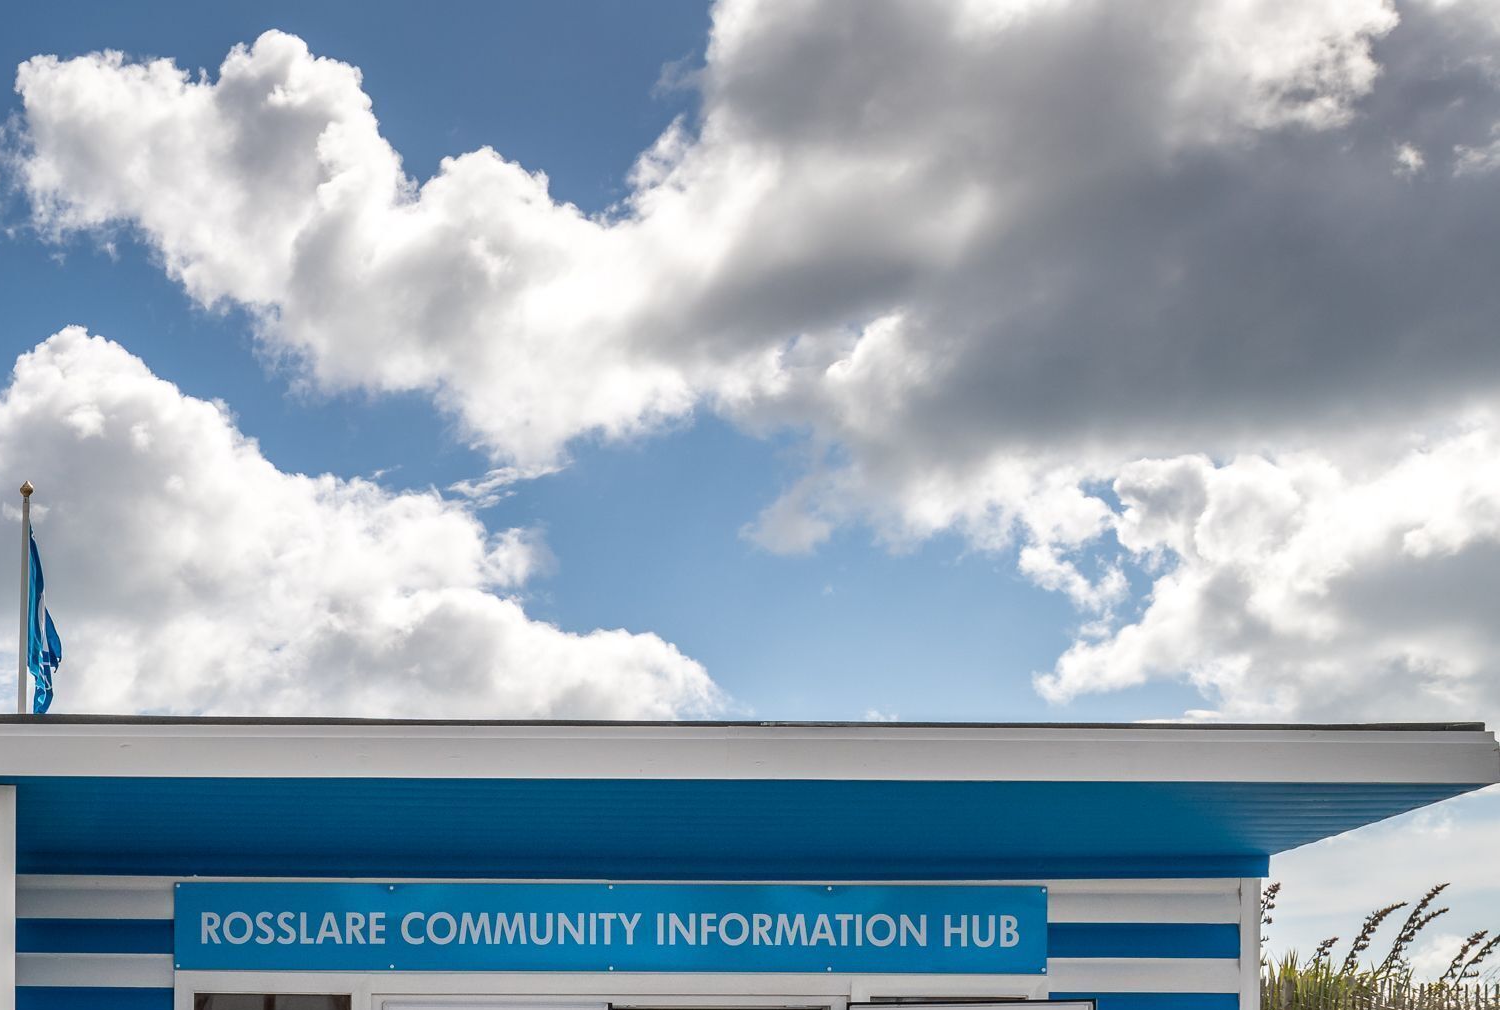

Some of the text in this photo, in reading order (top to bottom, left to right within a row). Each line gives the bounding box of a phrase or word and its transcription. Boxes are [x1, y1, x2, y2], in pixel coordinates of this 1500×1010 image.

[201, 911, 1021, 948] ROSSLARE COMMUNITY INFORMATION HUB
